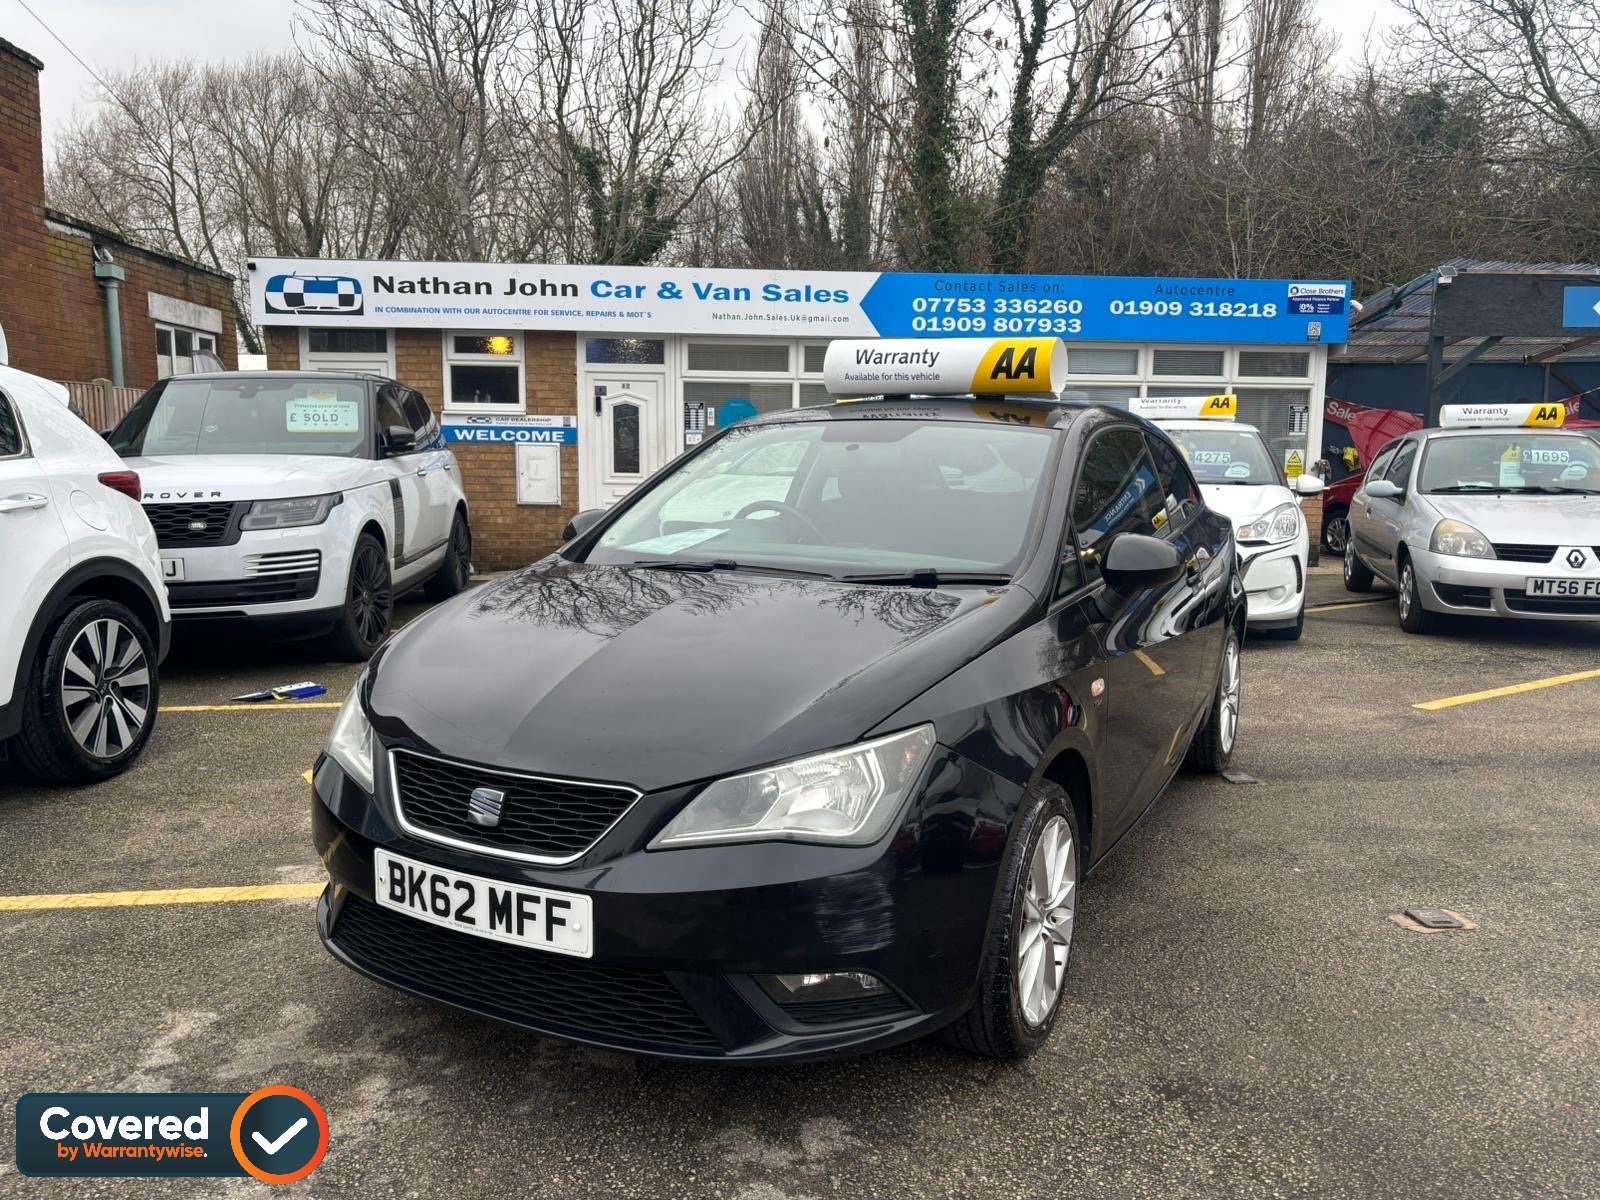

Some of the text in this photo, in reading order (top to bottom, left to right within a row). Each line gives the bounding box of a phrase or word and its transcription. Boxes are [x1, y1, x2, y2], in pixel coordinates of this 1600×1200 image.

[373, 275, 849, 303] Nathan John Car & Van Sales
[934, 280, 1065, 293] Contact Sales on:
[1155, 284, 1235, 296] Autocentre
[374, 306, 384, 314] IN
[385, 306, 440, 315] COMBINATION
[442, 307, 462, 315] WITH
[482, 308, 532, 317] AUTOCENTRE
[586, 310, 617, 318] REPAIRS
[912, 298, 1083, 314] 07753 336260
[1109, 300, 1277, 318] 01909 318218
[911, 316, 1082, 333] 01909 807933
[855, 348, 940, 368] Warranty
[990, 347, 1037, 380] AA
[844, 371, 940, 381] Available for this vehicle
[1210, 397, 1230, 409] AA
[303, 412, 339, 422] SOLD
[1326, 401, 1357, 421] Sale
[1461, 407, 1558, 420] Warranty AA
[453, 429, 565, 442] WELCOME
[143, 491, 222, 499] ROVER
[1533, 579, 1579, 595] MT56
[388, 859, 572, 942] BK62 MFF
